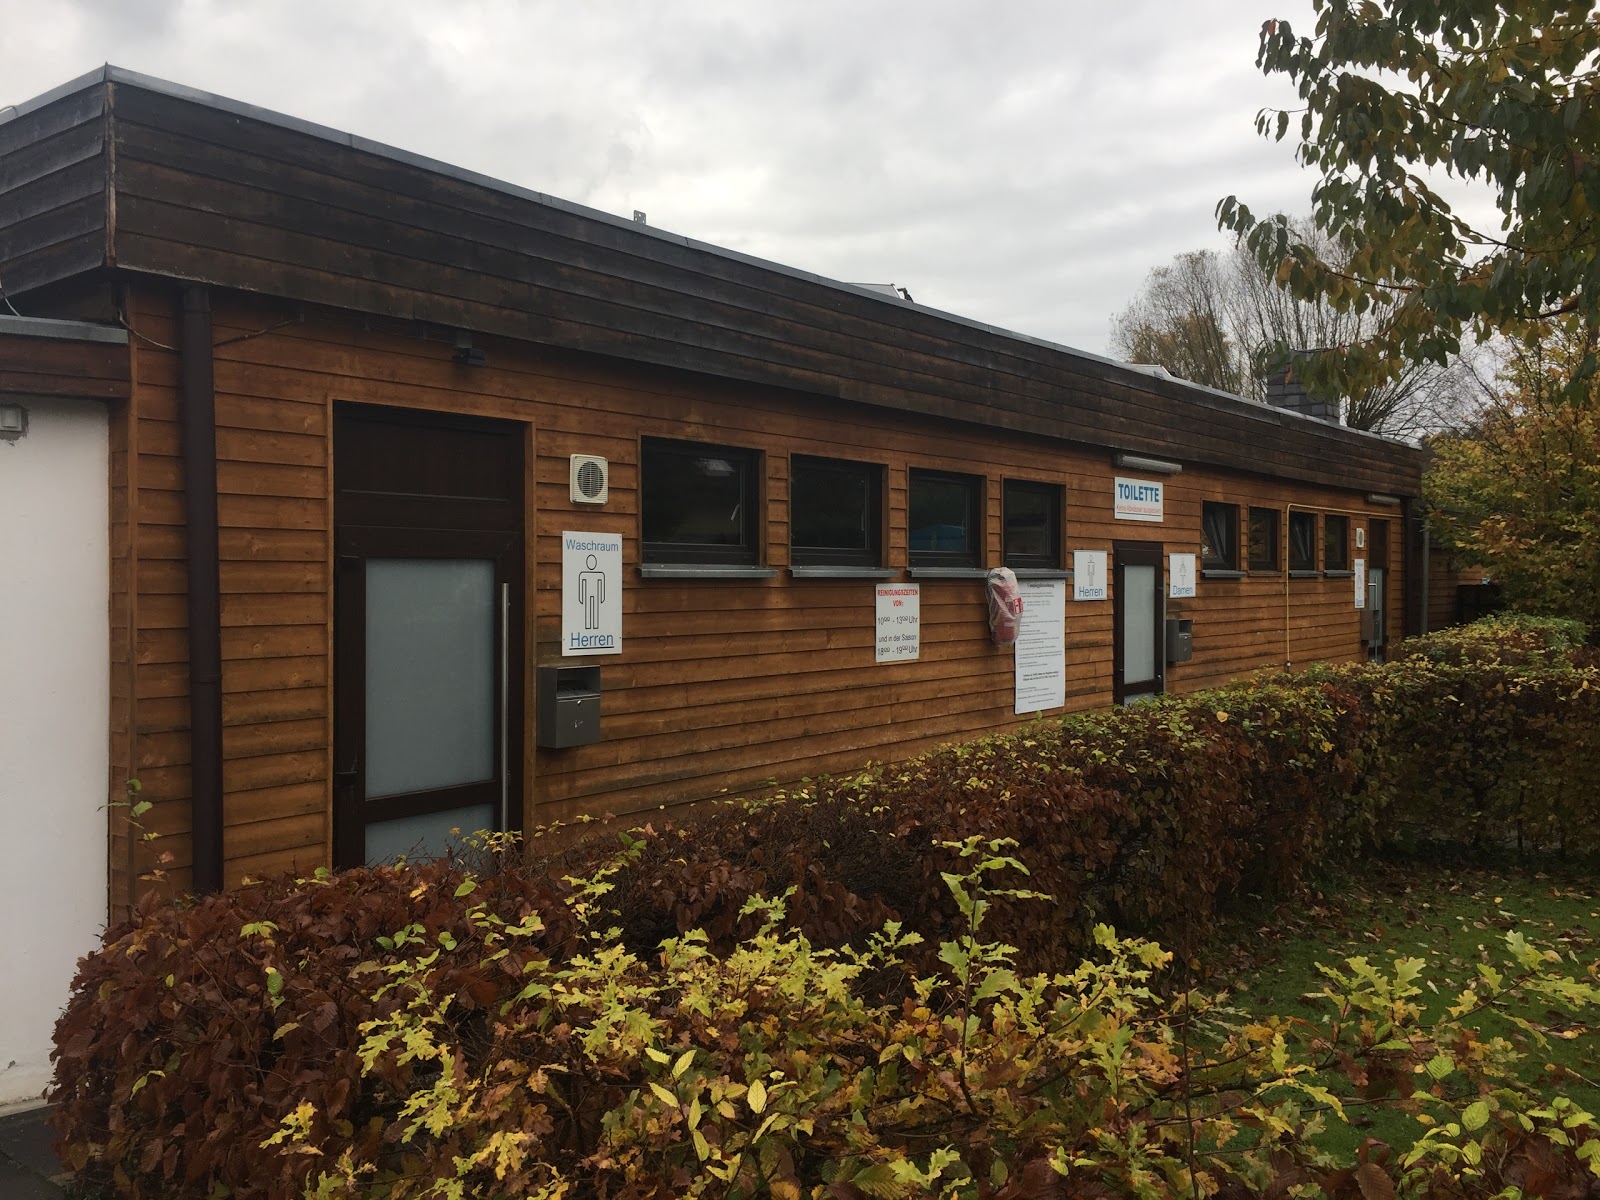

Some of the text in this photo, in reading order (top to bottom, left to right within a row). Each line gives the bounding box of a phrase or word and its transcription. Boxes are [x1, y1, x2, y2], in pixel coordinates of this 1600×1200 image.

[1118, 483, 1160, 503] TOILETTE
[566, 539, 619, 552] Waschraum
[1078, 586, 1103, 597] Herren
[1172, 585, 1193, 595] Damen
[908, 615, 918, 624] Uhr
[570, 632, 614, 648] Herren
[908, 645, 918, 654] Uhr
